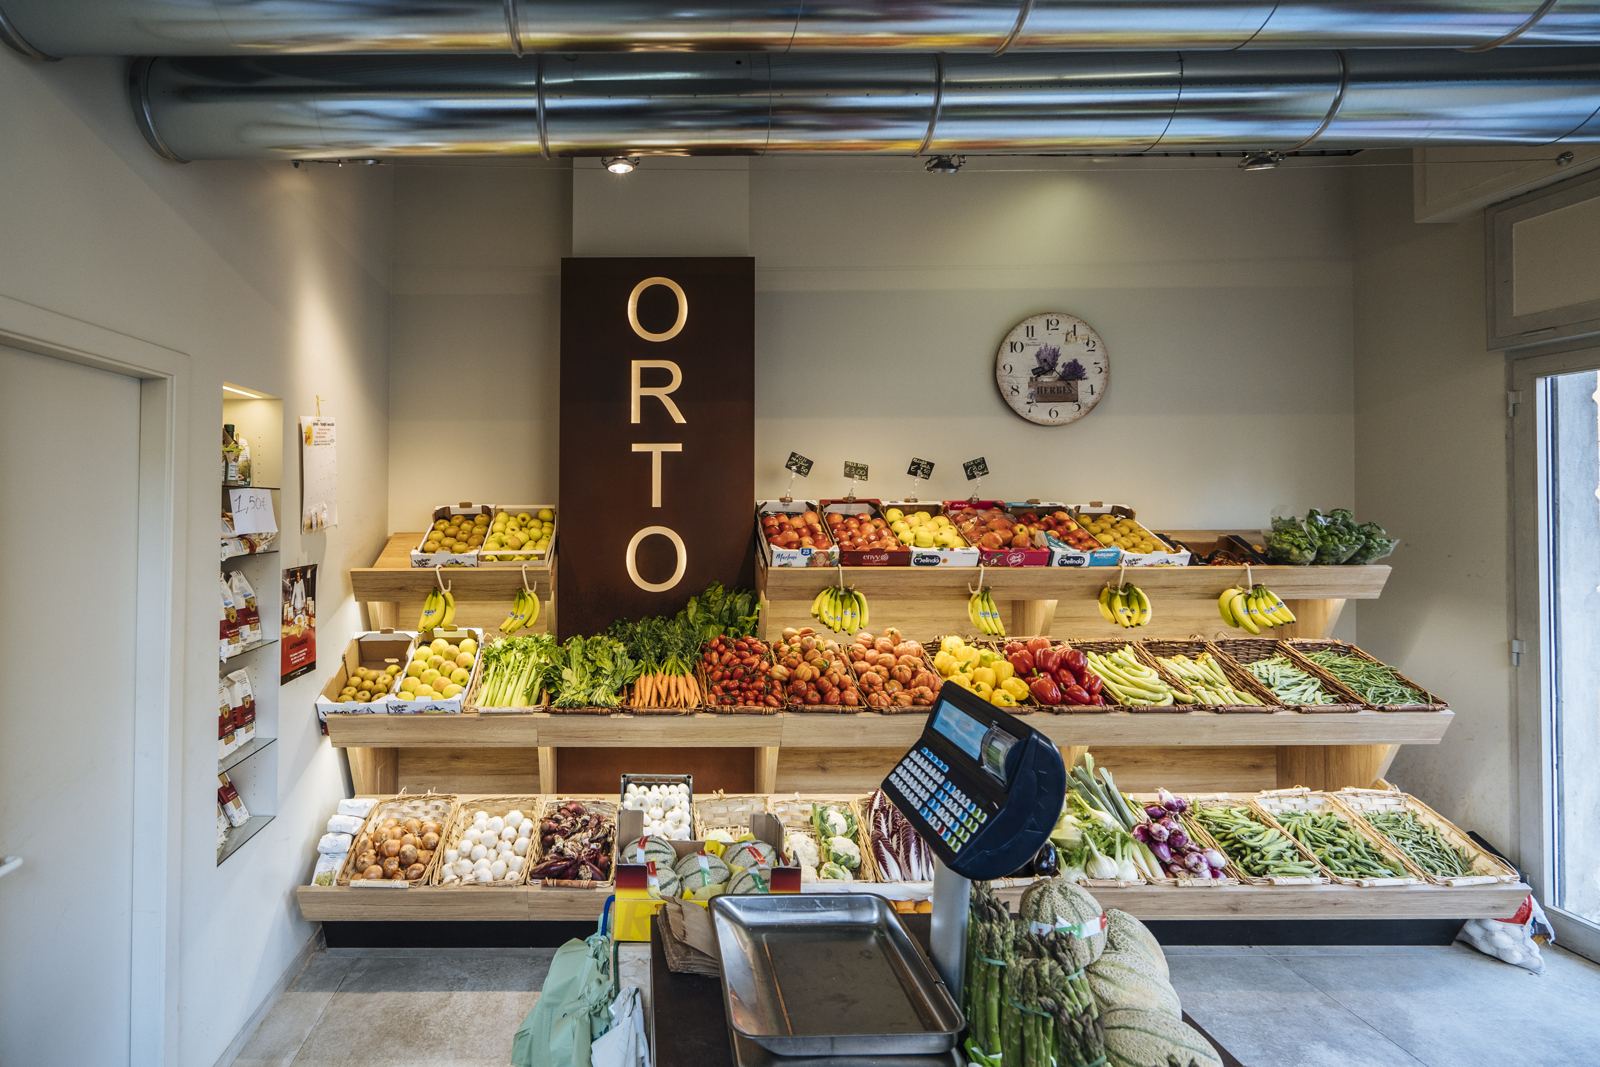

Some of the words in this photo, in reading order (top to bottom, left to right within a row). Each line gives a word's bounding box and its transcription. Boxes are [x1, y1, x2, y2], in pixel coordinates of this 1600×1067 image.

[1046, 318, 1060, 331] 12
[1026, 325, 1034, 338] 11
[1009, 341, 1024, 353] 10
[1086, 339, 1096, 352] 2
[1003, 364, 1013, 374] 9
[1010, 385, 1020, 395] 8
[1049, 408, 1059, 419] 6
[626, 276, 688, 593] ORTO
